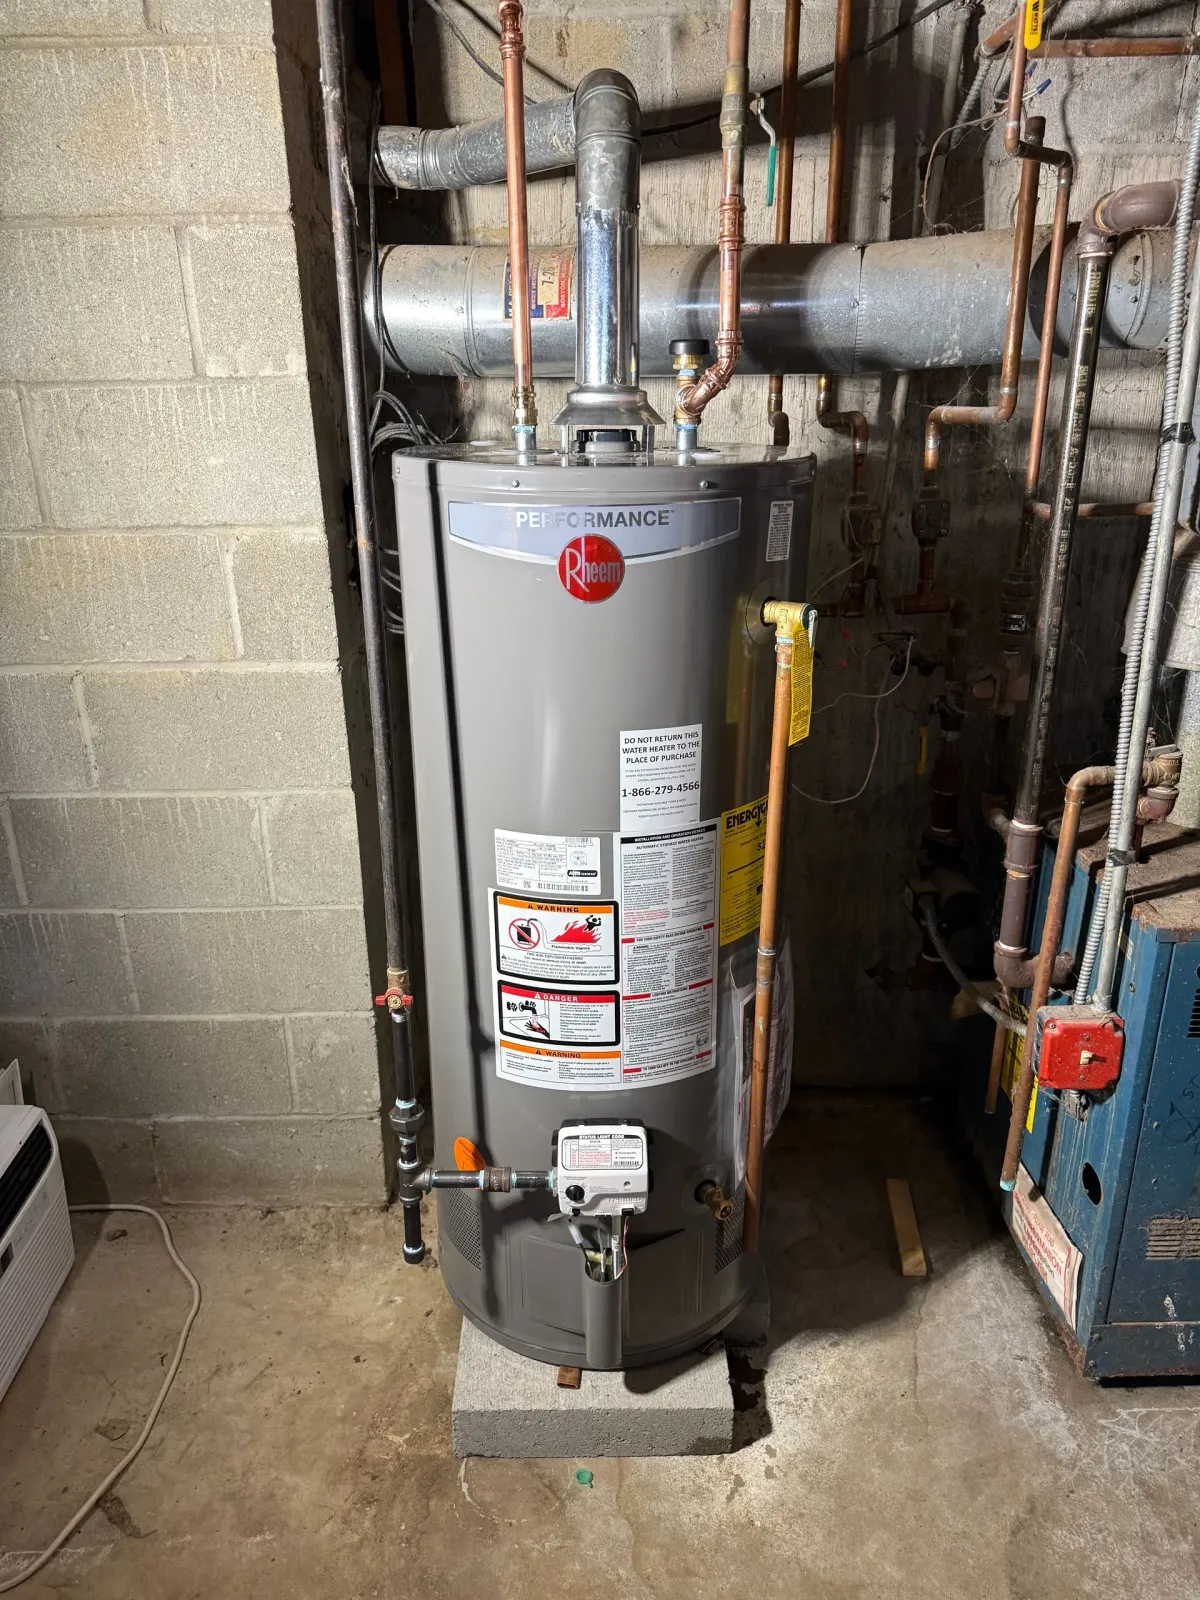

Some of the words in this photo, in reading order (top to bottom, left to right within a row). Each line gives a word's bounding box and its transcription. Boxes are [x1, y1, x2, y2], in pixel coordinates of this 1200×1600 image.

[516, 510, 671, 528] PERFORMANCE
[565, 539, 621, 592] Rheem
[654, 734, 682, 742] RETURN
[661, 751, 696, 761] PURCHASE
[622, 781, 700, 797] 1-866-279-4566
[537, 904, 579, 913] WARNING
[543, 994, 578, 1002] DANGER
